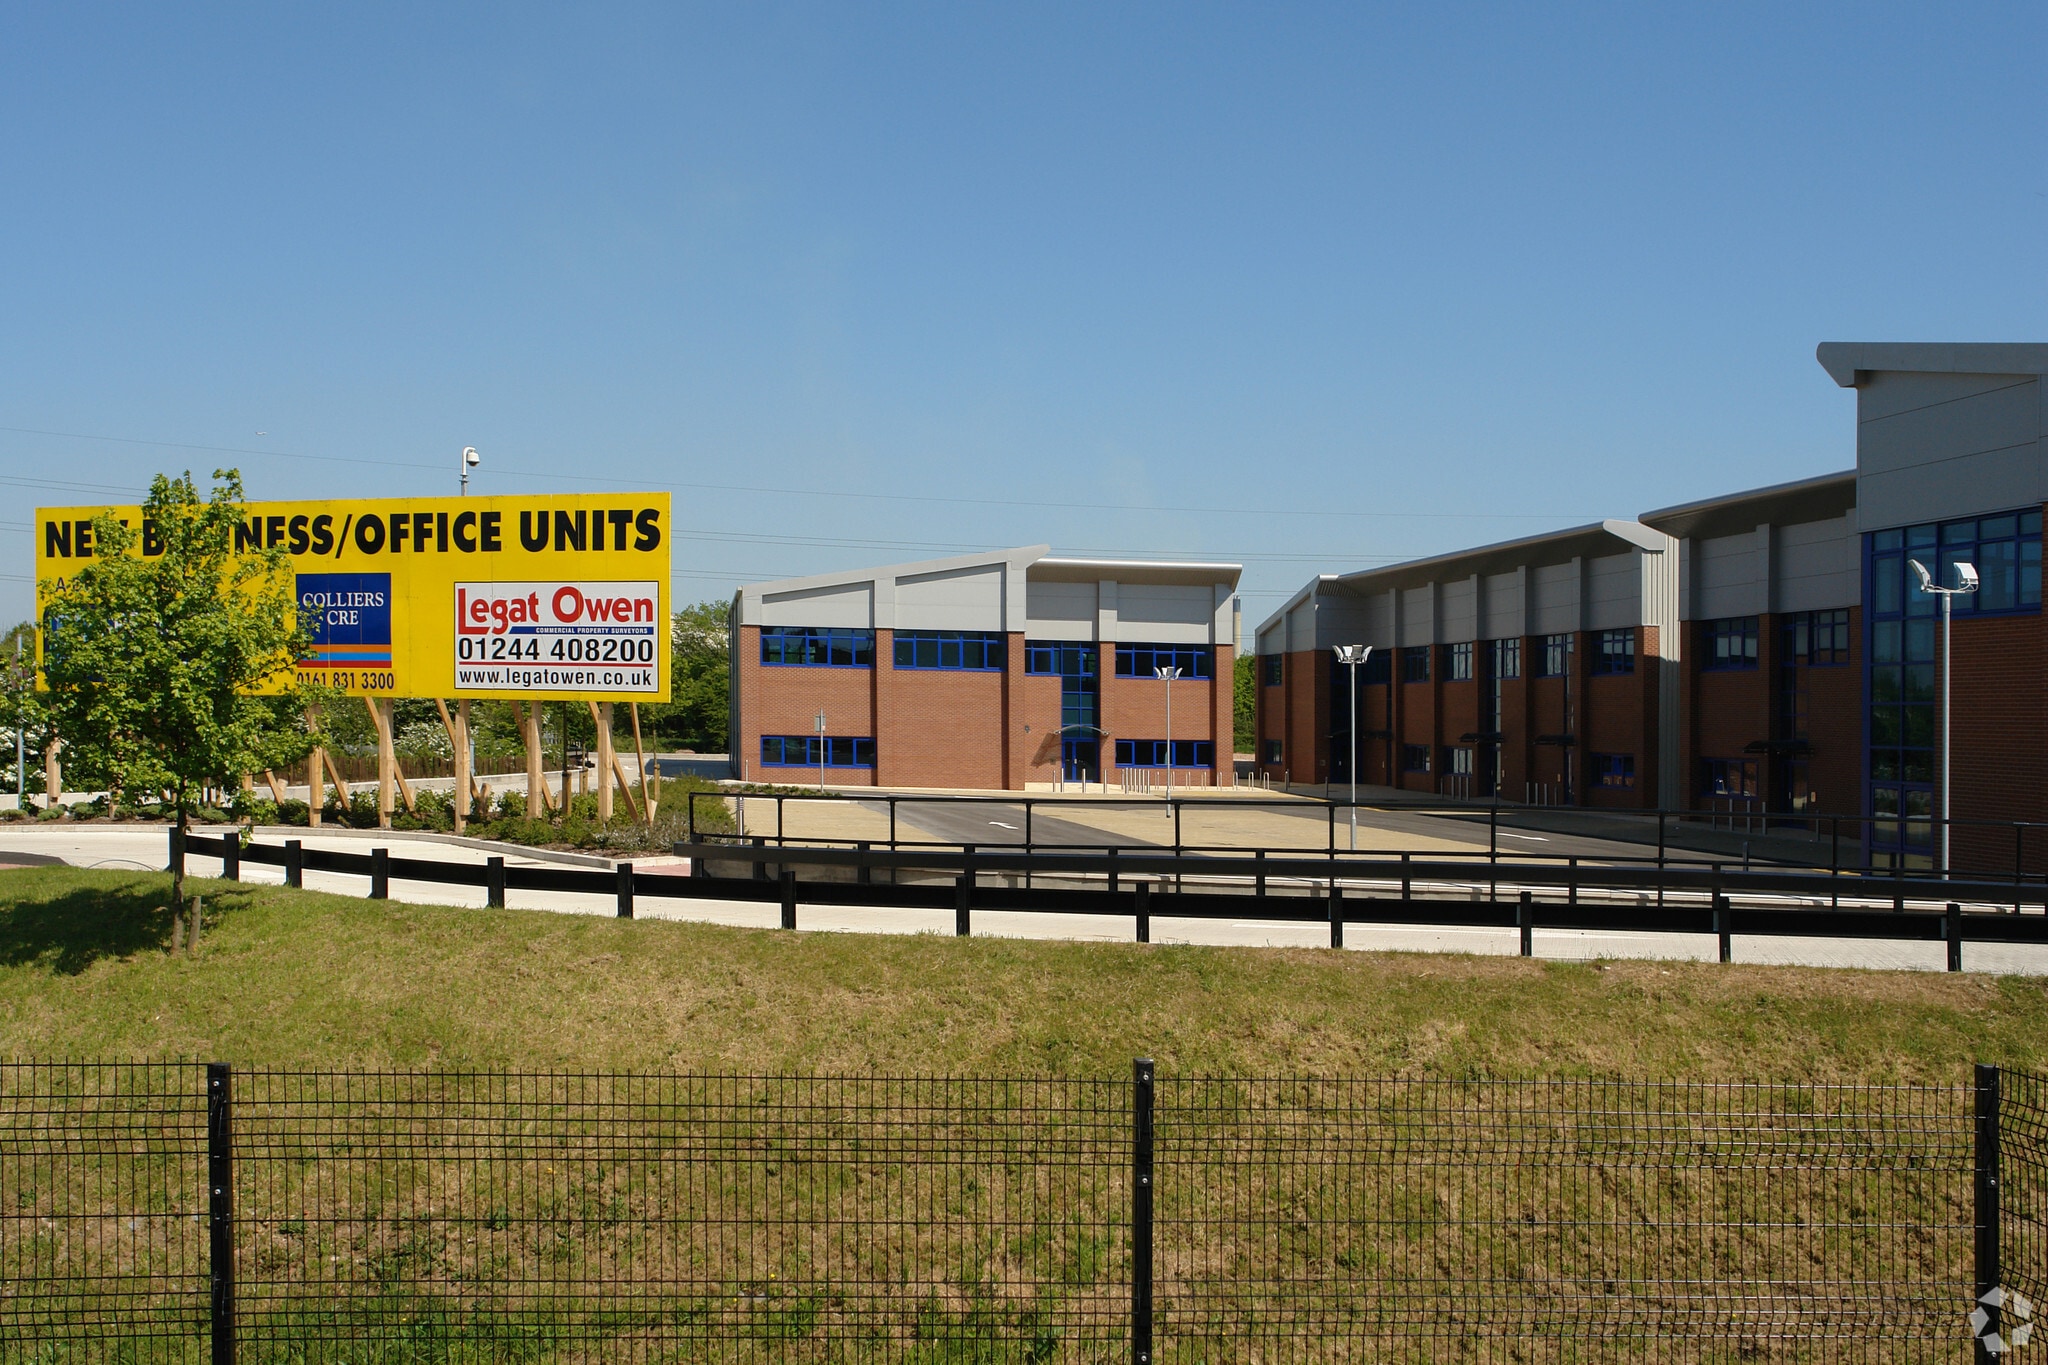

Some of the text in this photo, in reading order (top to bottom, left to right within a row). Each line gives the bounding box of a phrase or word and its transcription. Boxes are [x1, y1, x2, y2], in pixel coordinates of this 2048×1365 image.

[46, 508, 661, 559] NE BNESS/OFFICE UNITS
[302, 592, 385, 607] COLLIERS
[326, 610, 359, 626] CRE
[458, 586, 654, 635] Legat Owen
[611, 627, 648, 635] SURVEYORS
[458, 637, 654, 662] 01244 408200
[296, 671, 395, 690] 0161 831 3300
[459, 668, 652, 687] www.legatowen.co.uk
